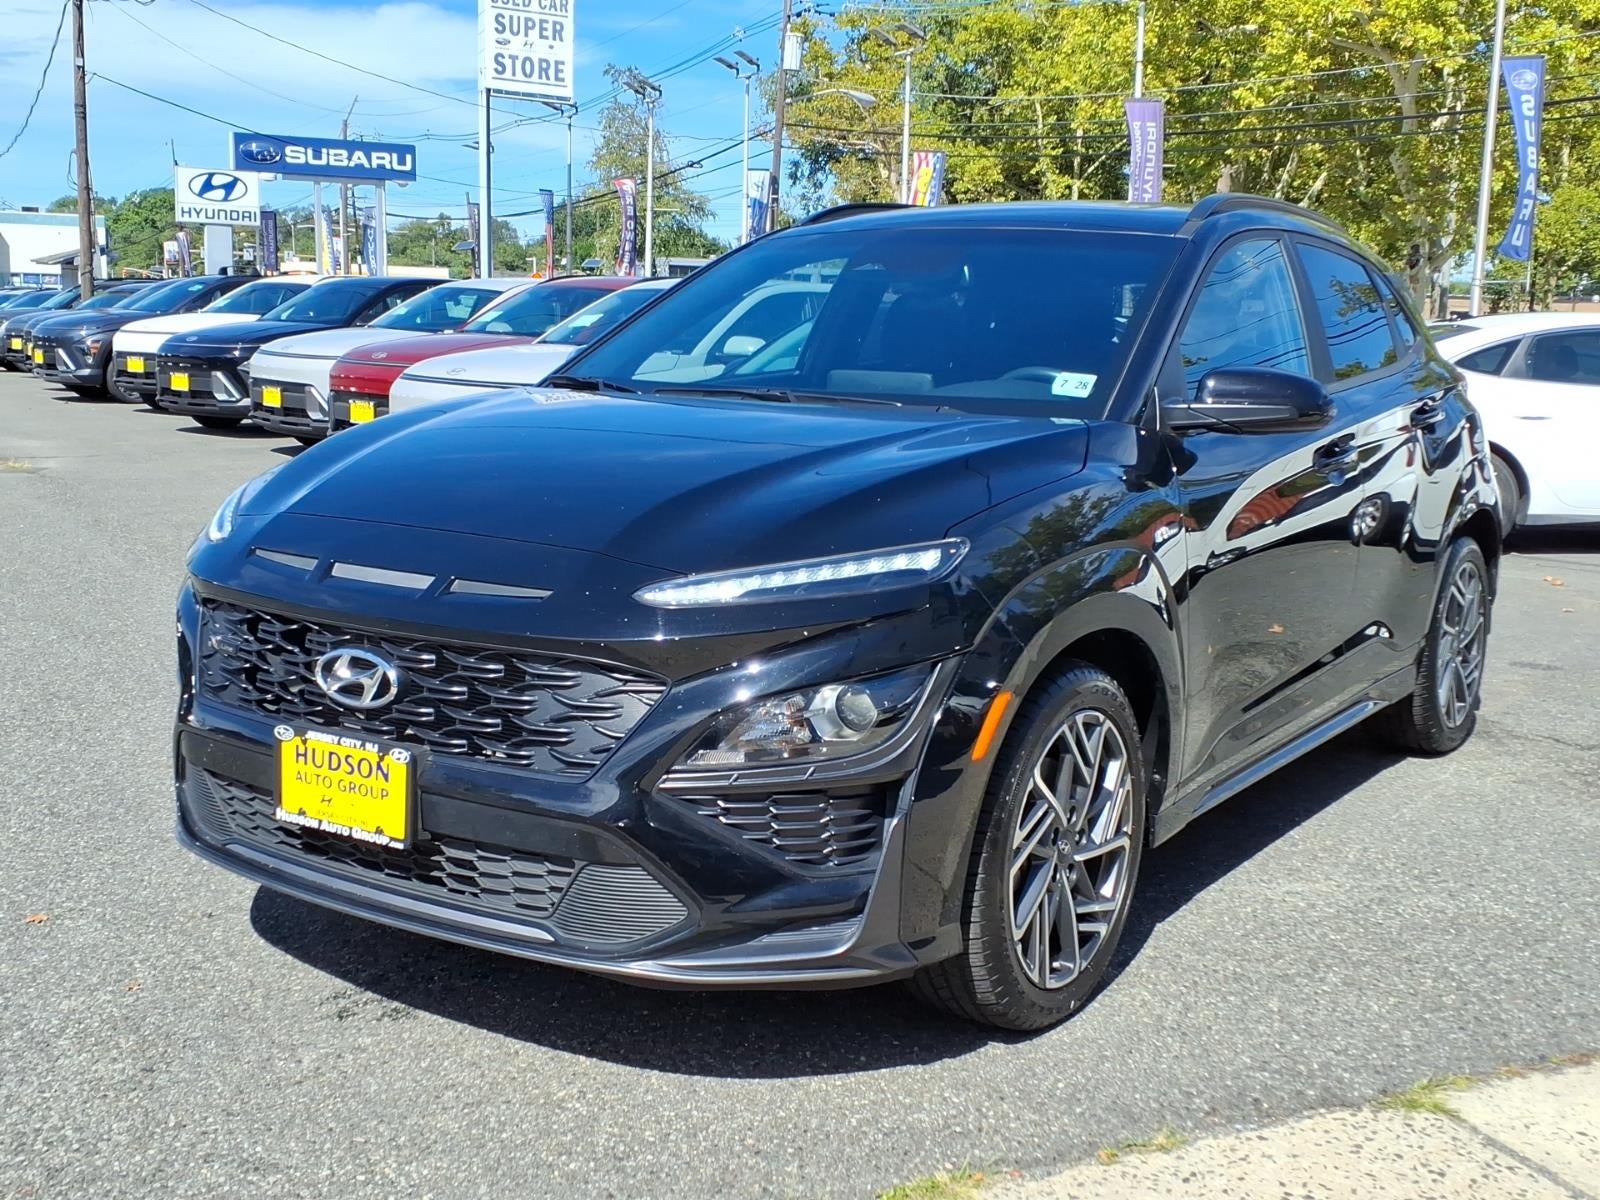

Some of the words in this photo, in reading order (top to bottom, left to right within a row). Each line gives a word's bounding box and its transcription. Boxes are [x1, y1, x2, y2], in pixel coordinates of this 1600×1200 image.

[494, 12, 565, 42] SUPER
[493, 51, 566, 83] STORE
[284, 145, 412, 172] SUBARU
[180, 206, 257, 223] HYUNDAI
[1060, 379, 1068, 388] 7
[1074, 381, 1089, 390] 28
[295, 744, 390, 783] HUDSON
[296, 770, 332, 789] AUTO
[337, 779, 390, 801] GROUP
